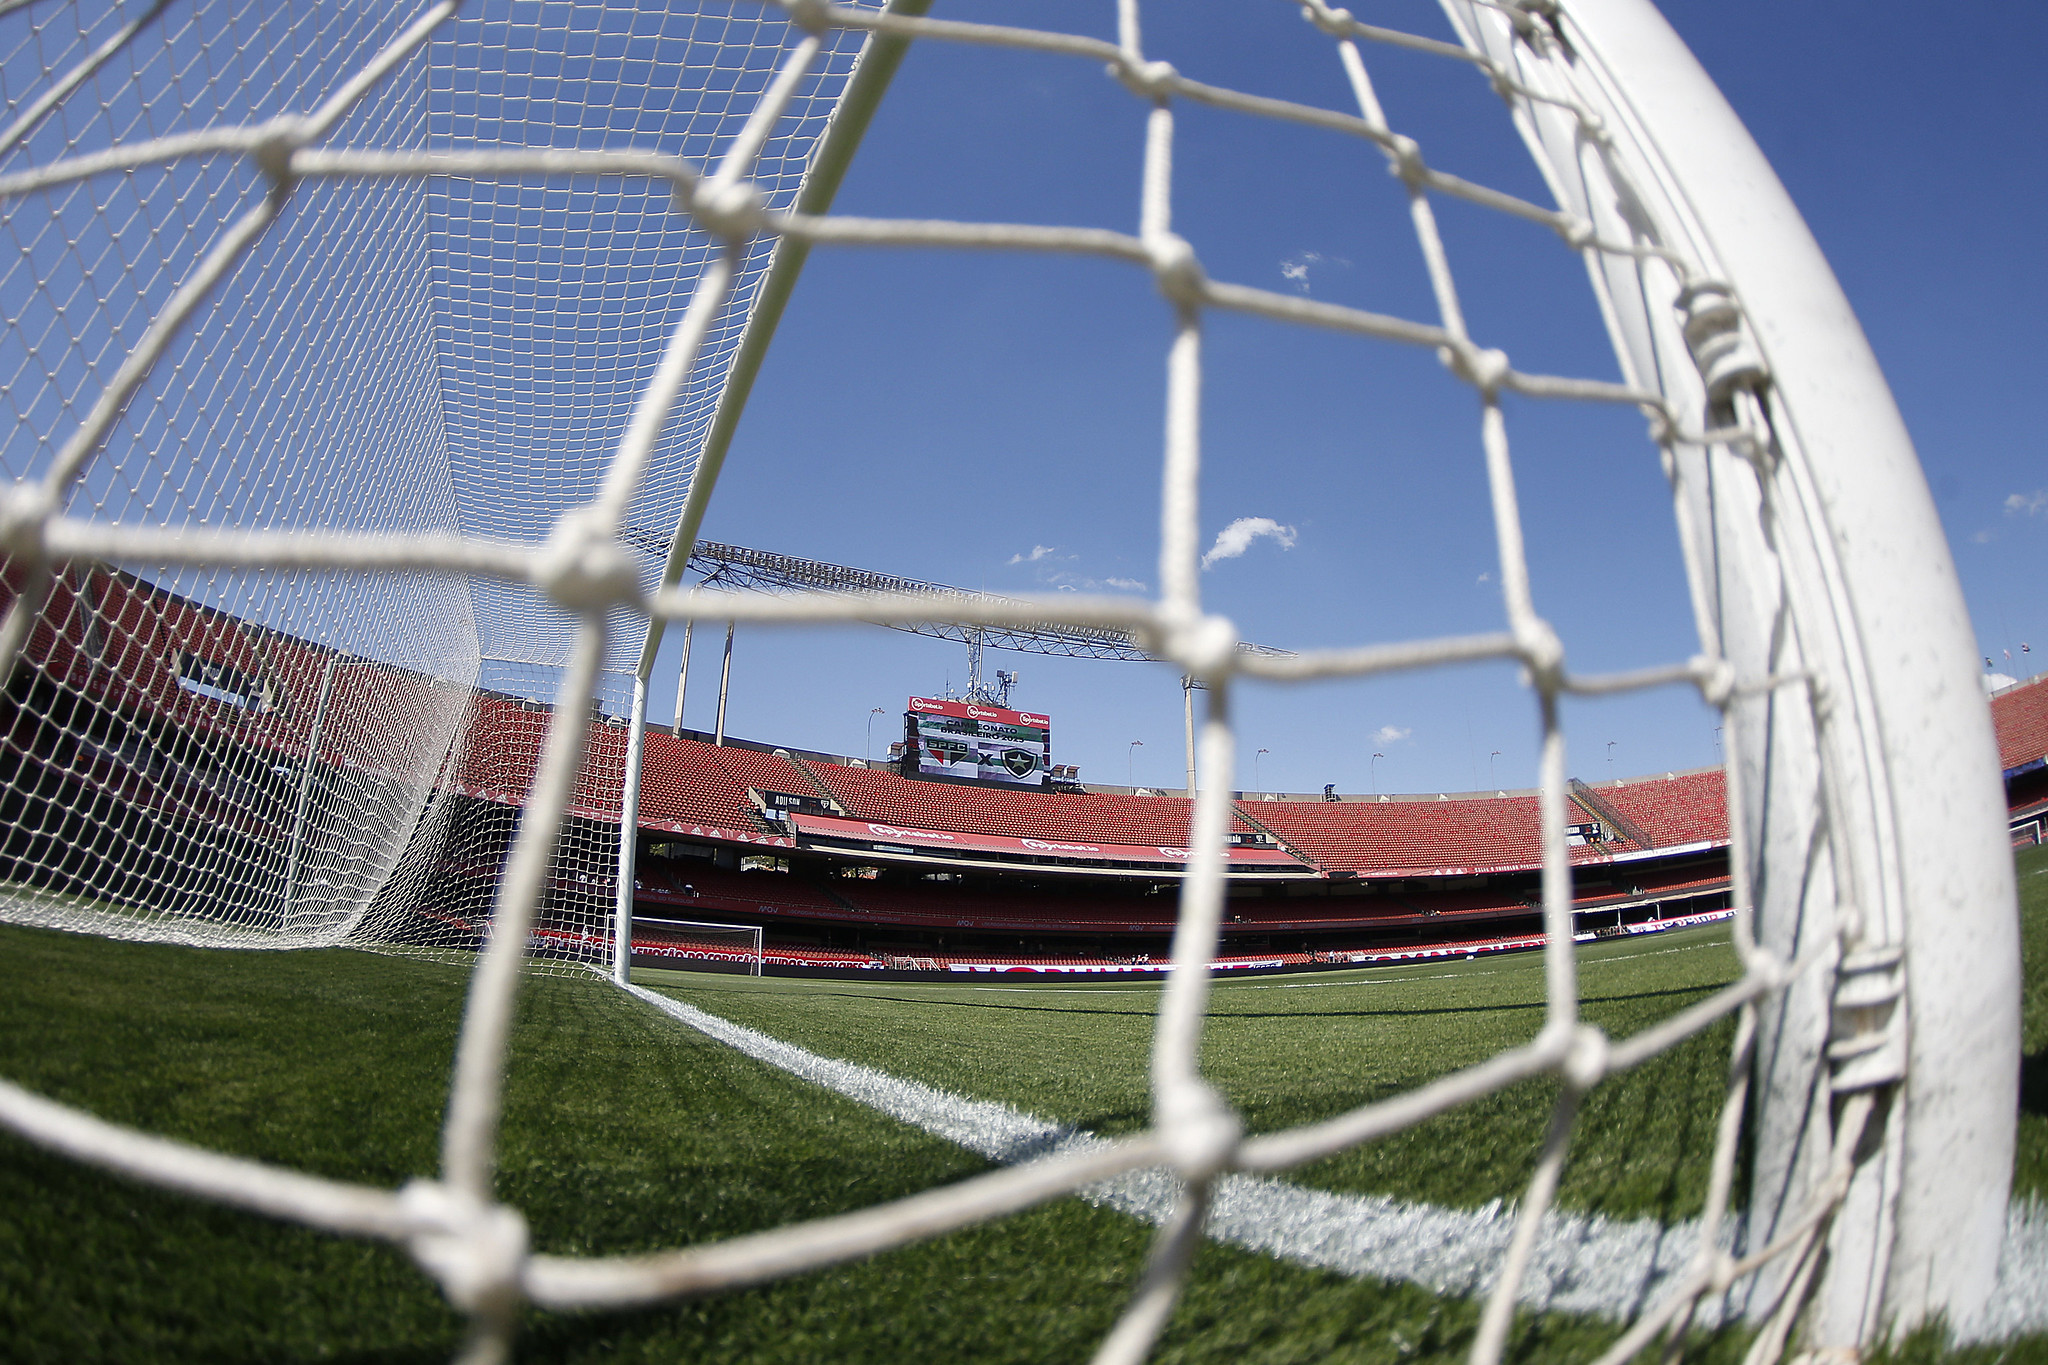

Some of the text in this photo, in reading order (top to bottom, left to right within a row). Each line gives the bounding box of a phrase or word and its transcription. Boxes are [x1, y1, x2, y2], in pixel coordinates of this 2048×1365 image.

[941, 727, 999, 740] BRASILEIRO
[946, 720, 1017, 734] CAMPEONATO
[928, 741, 966, 750] SPFC
